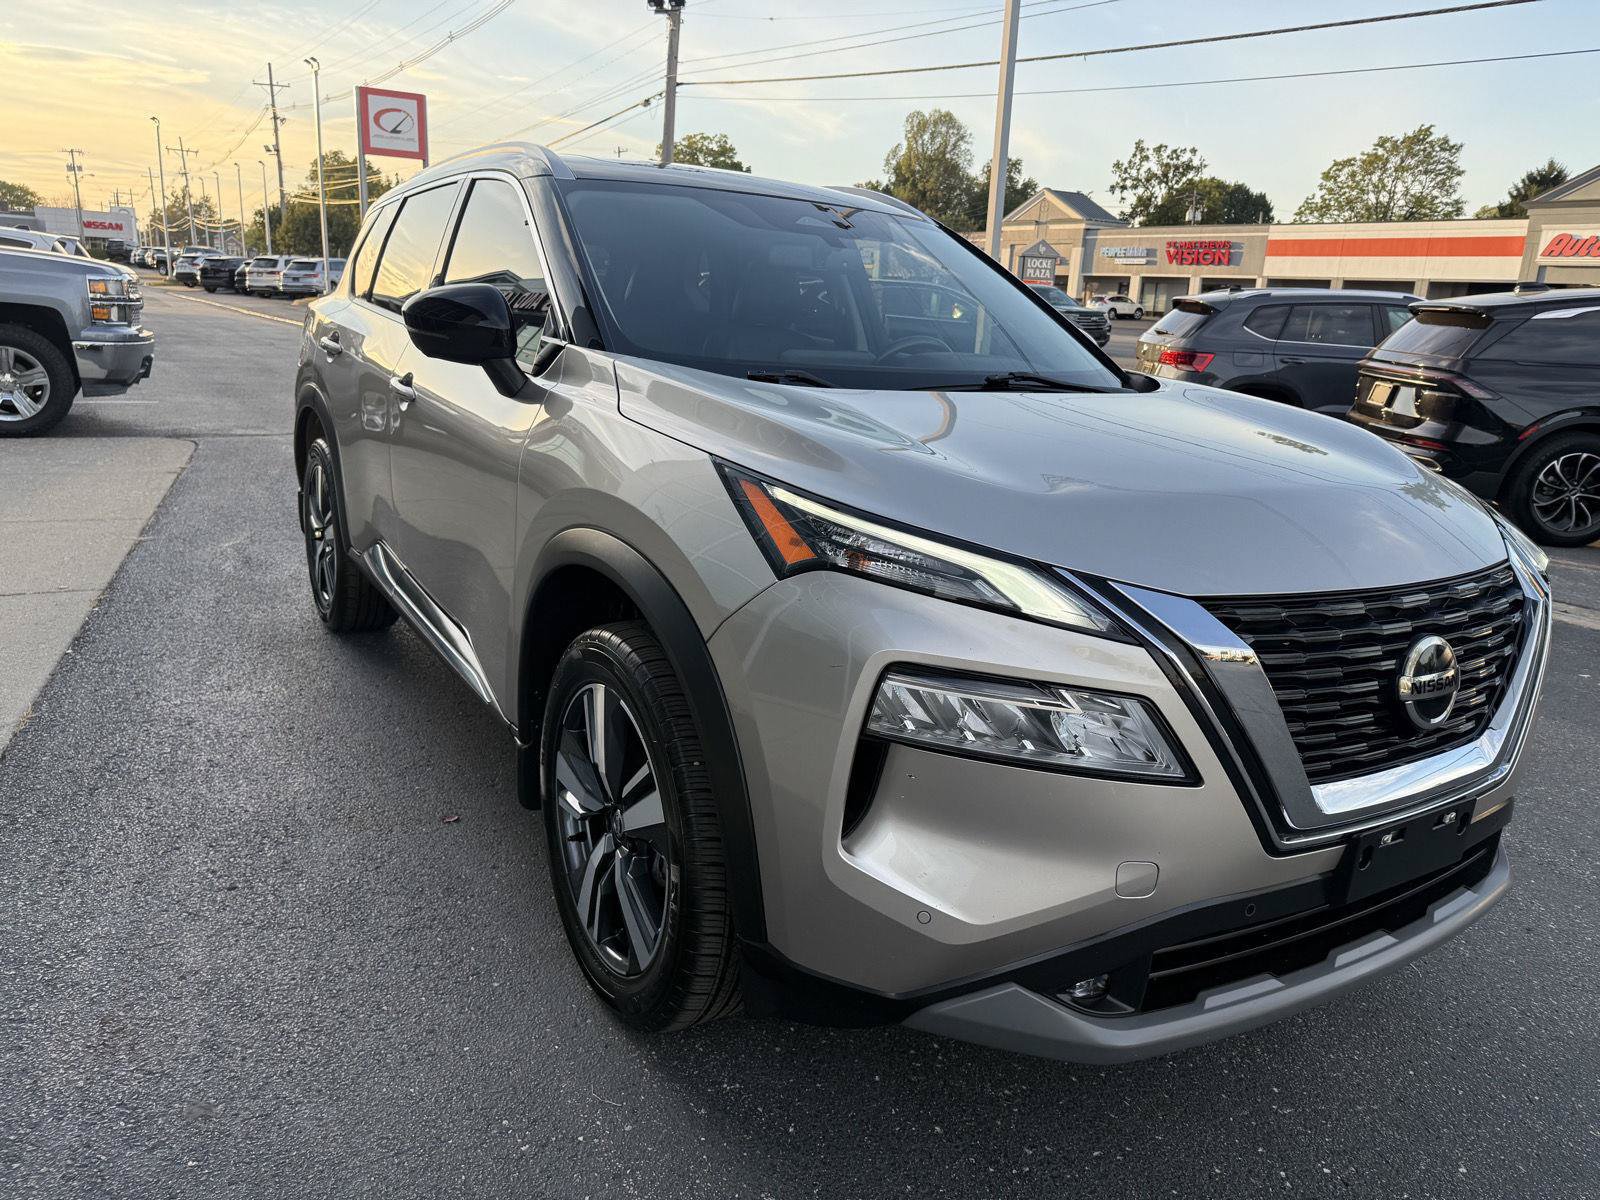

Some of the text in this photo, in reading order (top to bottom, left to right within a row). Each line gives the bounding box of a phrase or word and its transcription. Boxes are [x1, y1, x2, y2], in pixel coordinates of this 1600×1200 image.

[82, 220, 124, 231] NISSAN
[1178, 240, 1232, 249] MATTHEWS
[1165, 249, 1230, 266] VISION
[1027, 258, 1052, 268] LOCKE
[1026, 268, 1050, 278] PLAZA
[1411, 675, 1456, 695] NISSAN
